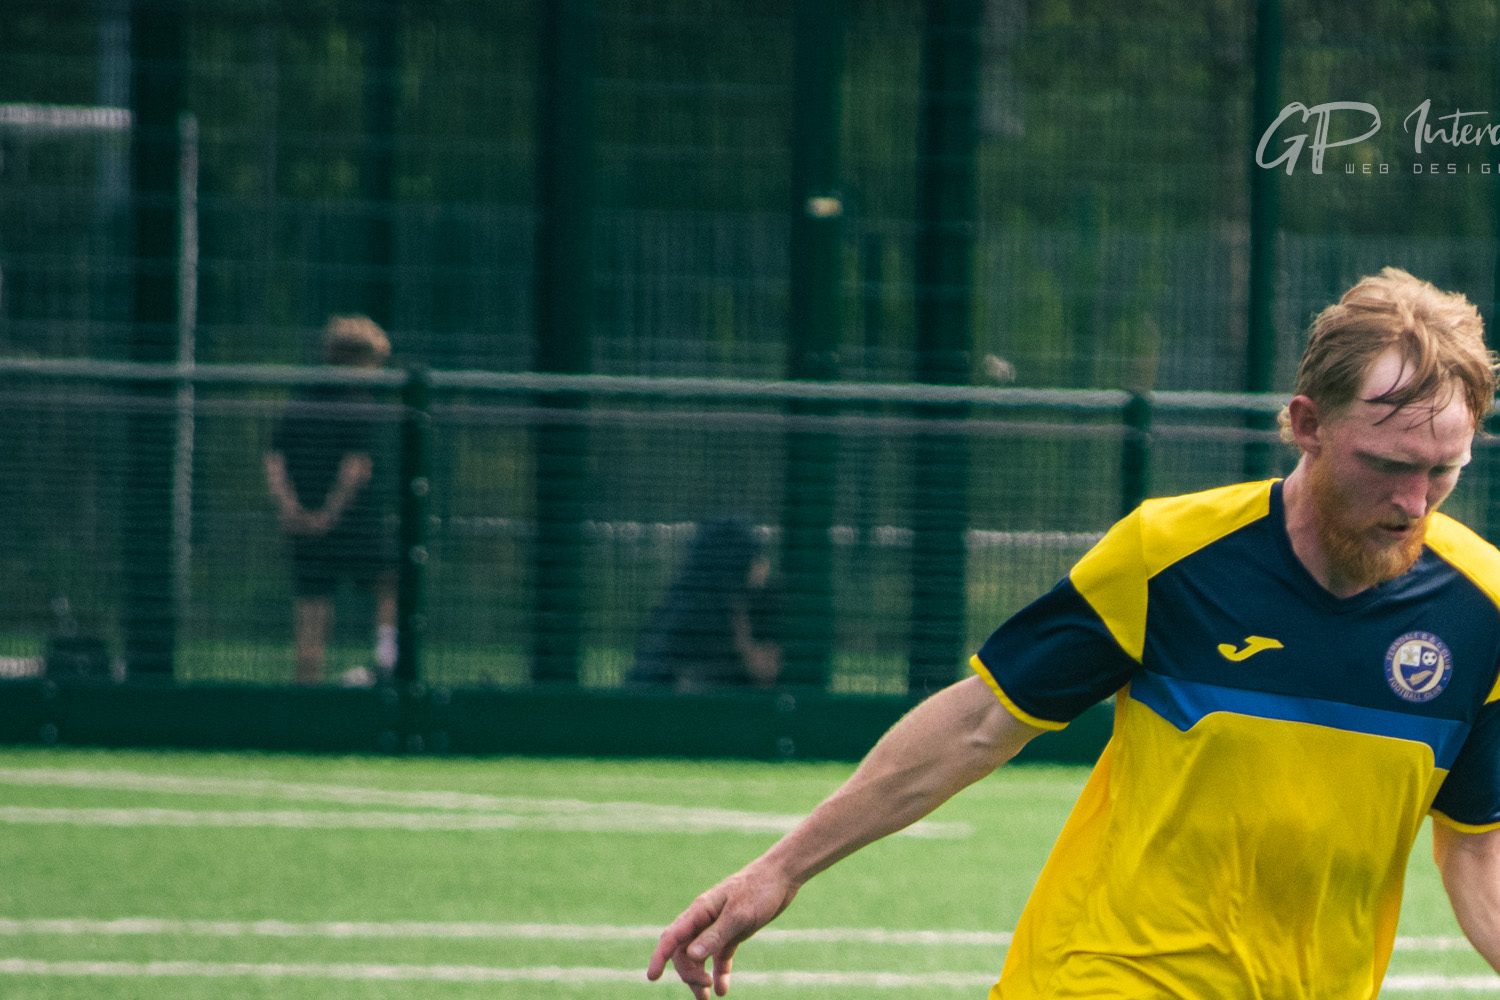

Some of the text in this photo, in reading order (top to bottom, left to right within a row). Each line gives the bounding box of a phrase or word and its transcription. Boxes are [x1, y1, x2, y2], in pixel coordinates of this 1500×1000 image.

[1387, 632, 1419, 661] FERNDALE
[1388, 677, 1442, 700] FOOTBALL CLUB
